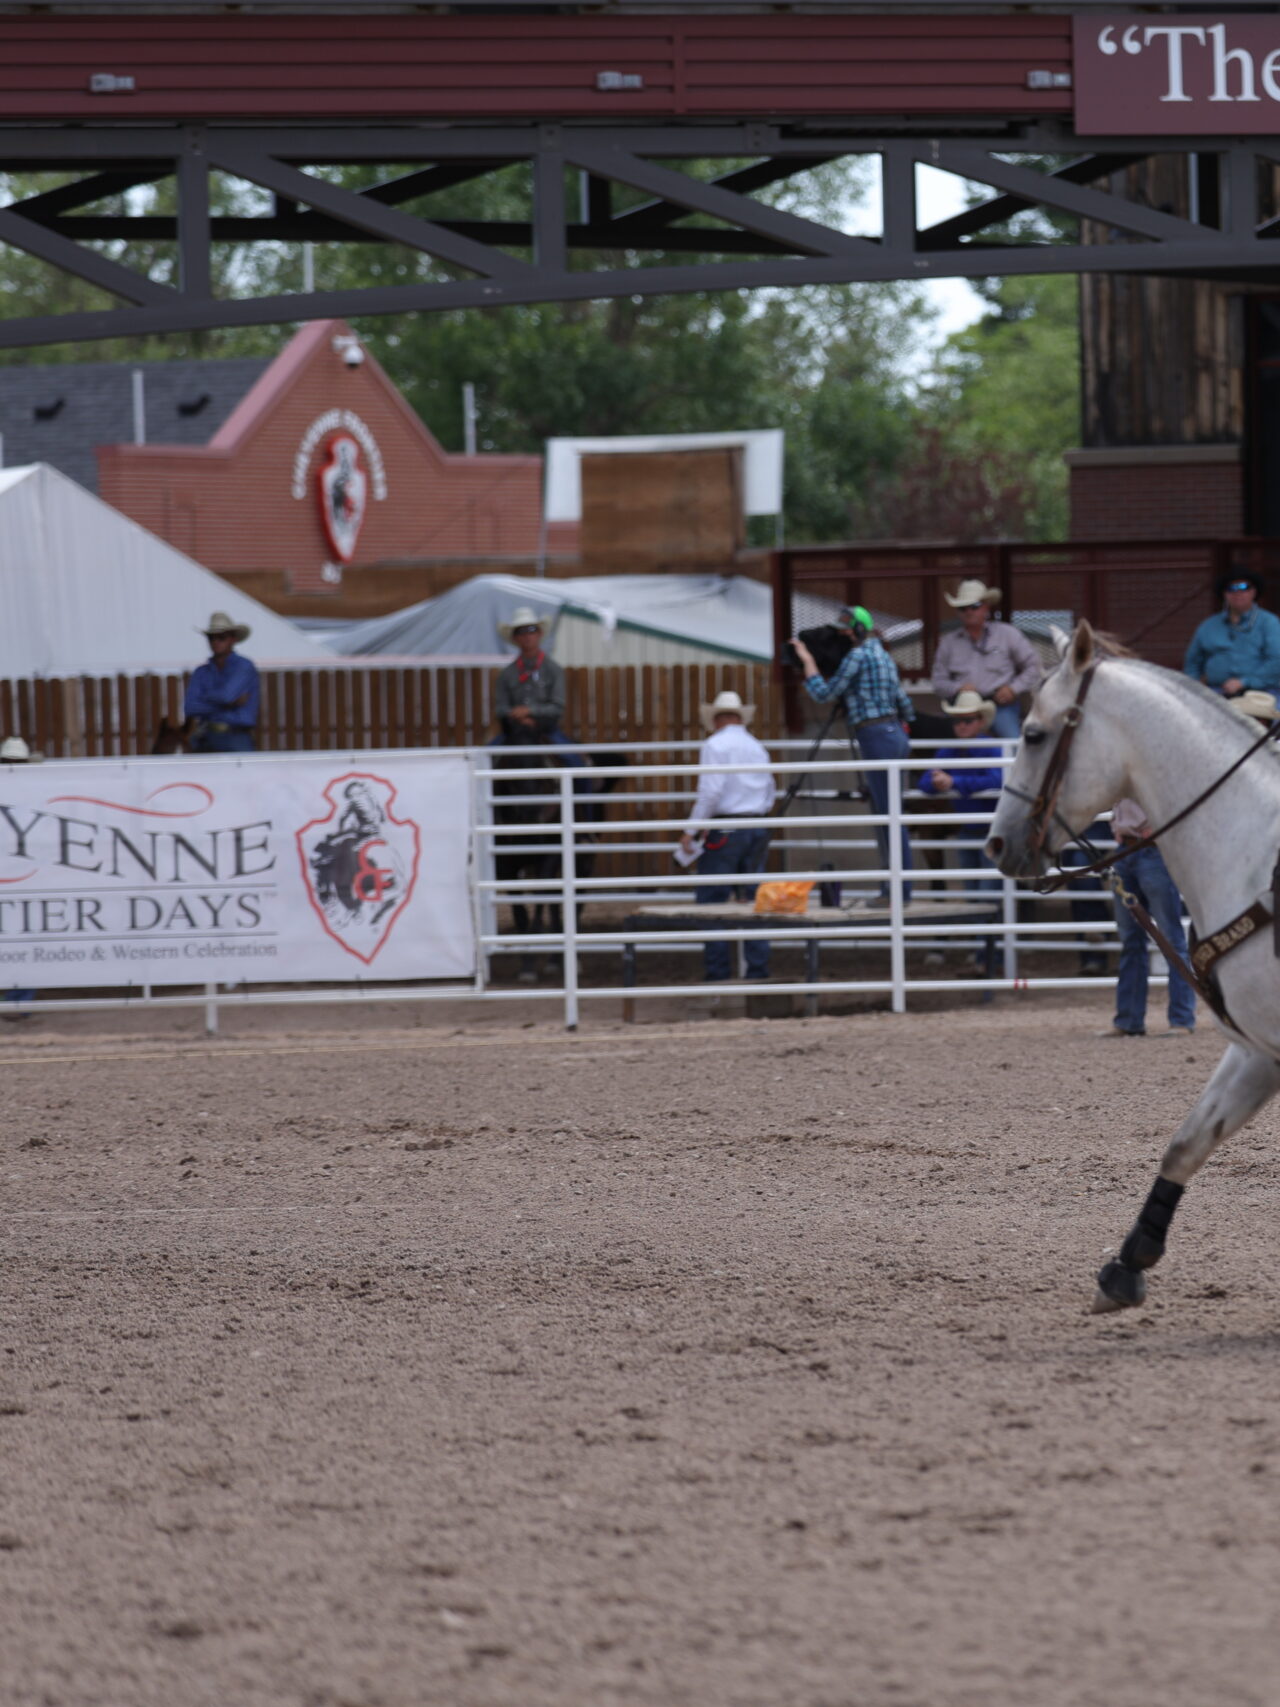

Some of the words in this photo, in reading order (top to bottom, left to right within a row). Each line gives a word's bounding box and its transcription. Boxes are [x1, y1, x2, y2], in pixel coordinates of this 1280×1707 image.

[0, 805, 277, 882] YENNE
[126, 892, 262, 931] DAYS
[33, 945, 86, 963] Rodeo
[91, 944, 106, 961] &
[112, 943, 179, 960] Western
[184, 940, 278, 958] Celebration
